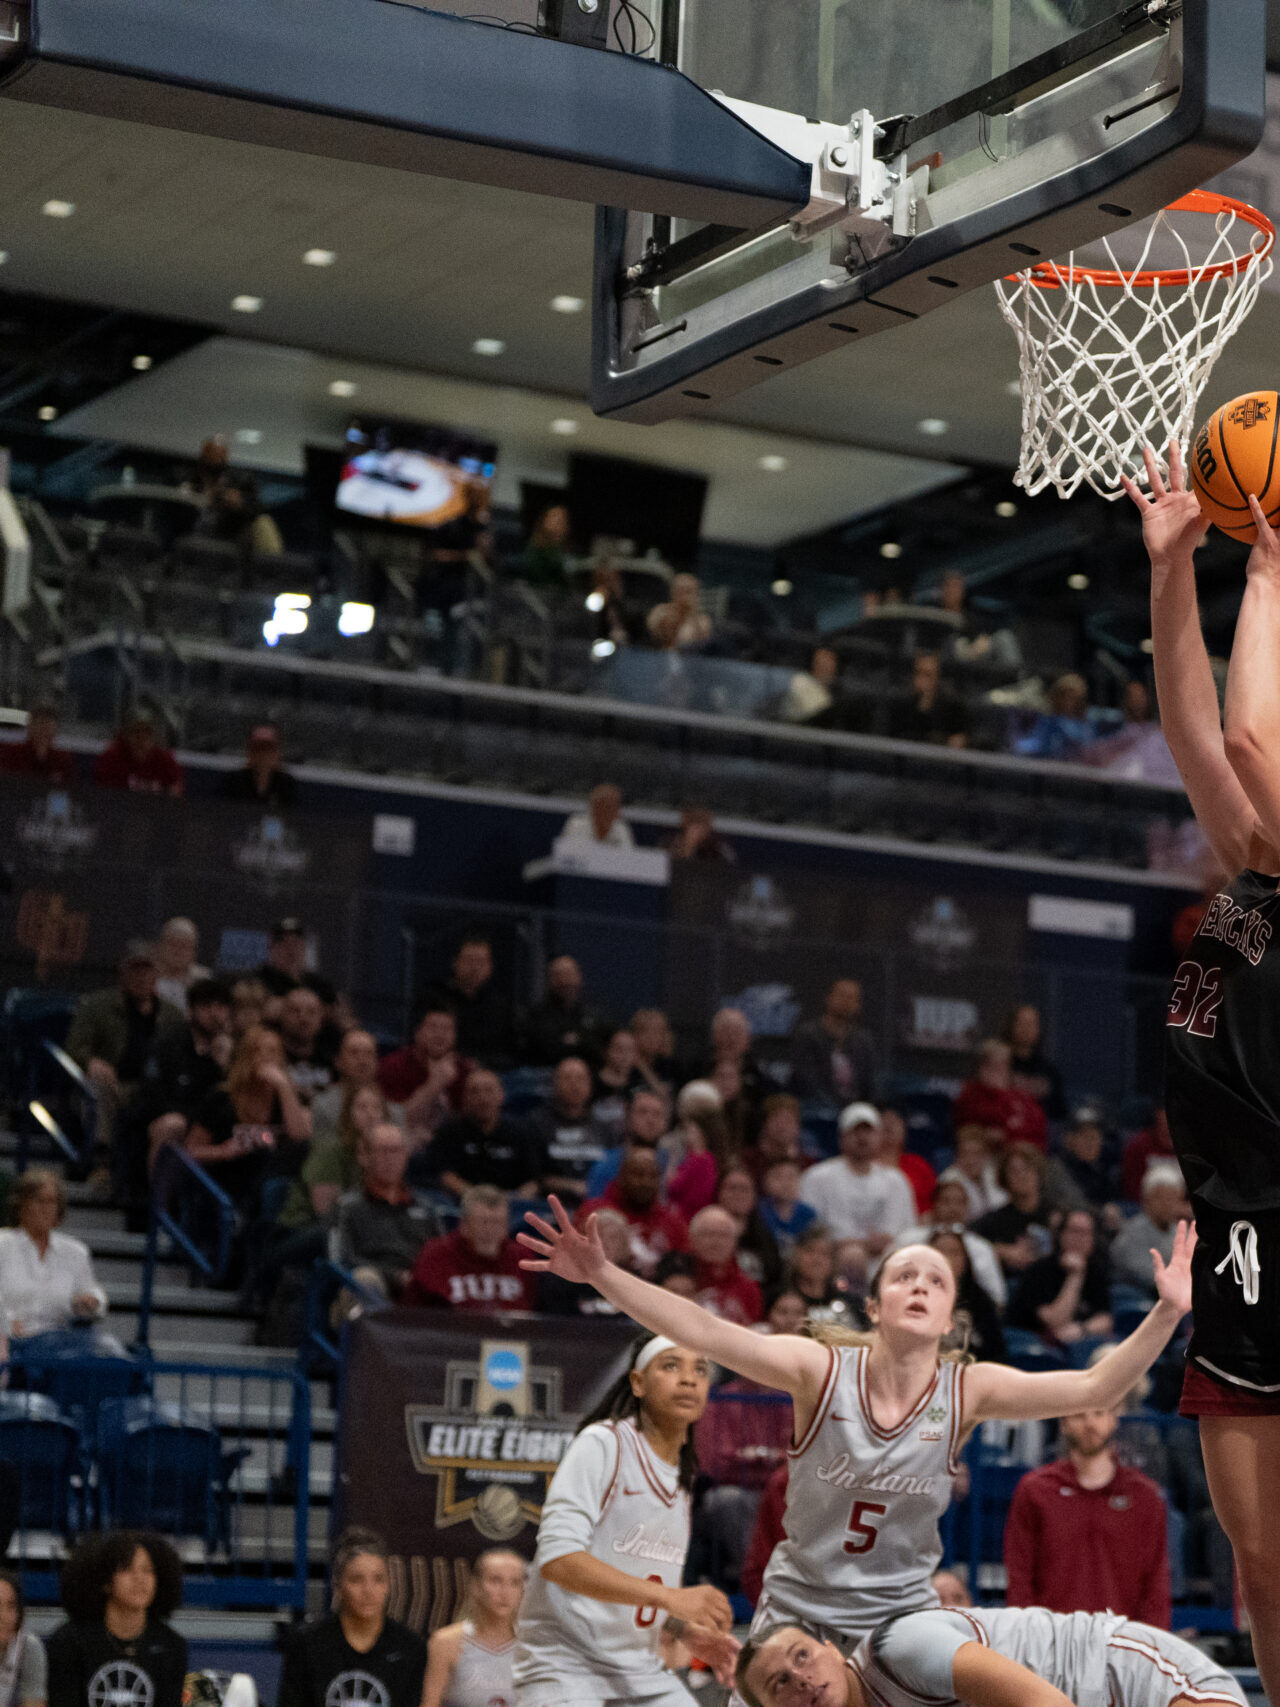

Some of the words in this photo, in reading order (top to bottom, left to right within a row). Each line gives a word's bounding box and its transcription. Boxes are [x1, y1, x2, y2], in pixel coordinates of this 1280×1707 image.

[1166, 960, 1224, 1039] 32
[449, 1273, 523, 1303] IUP
[427, 1423, 500, 1459] ELITE
[843, 1500, 887, 1554] 5
